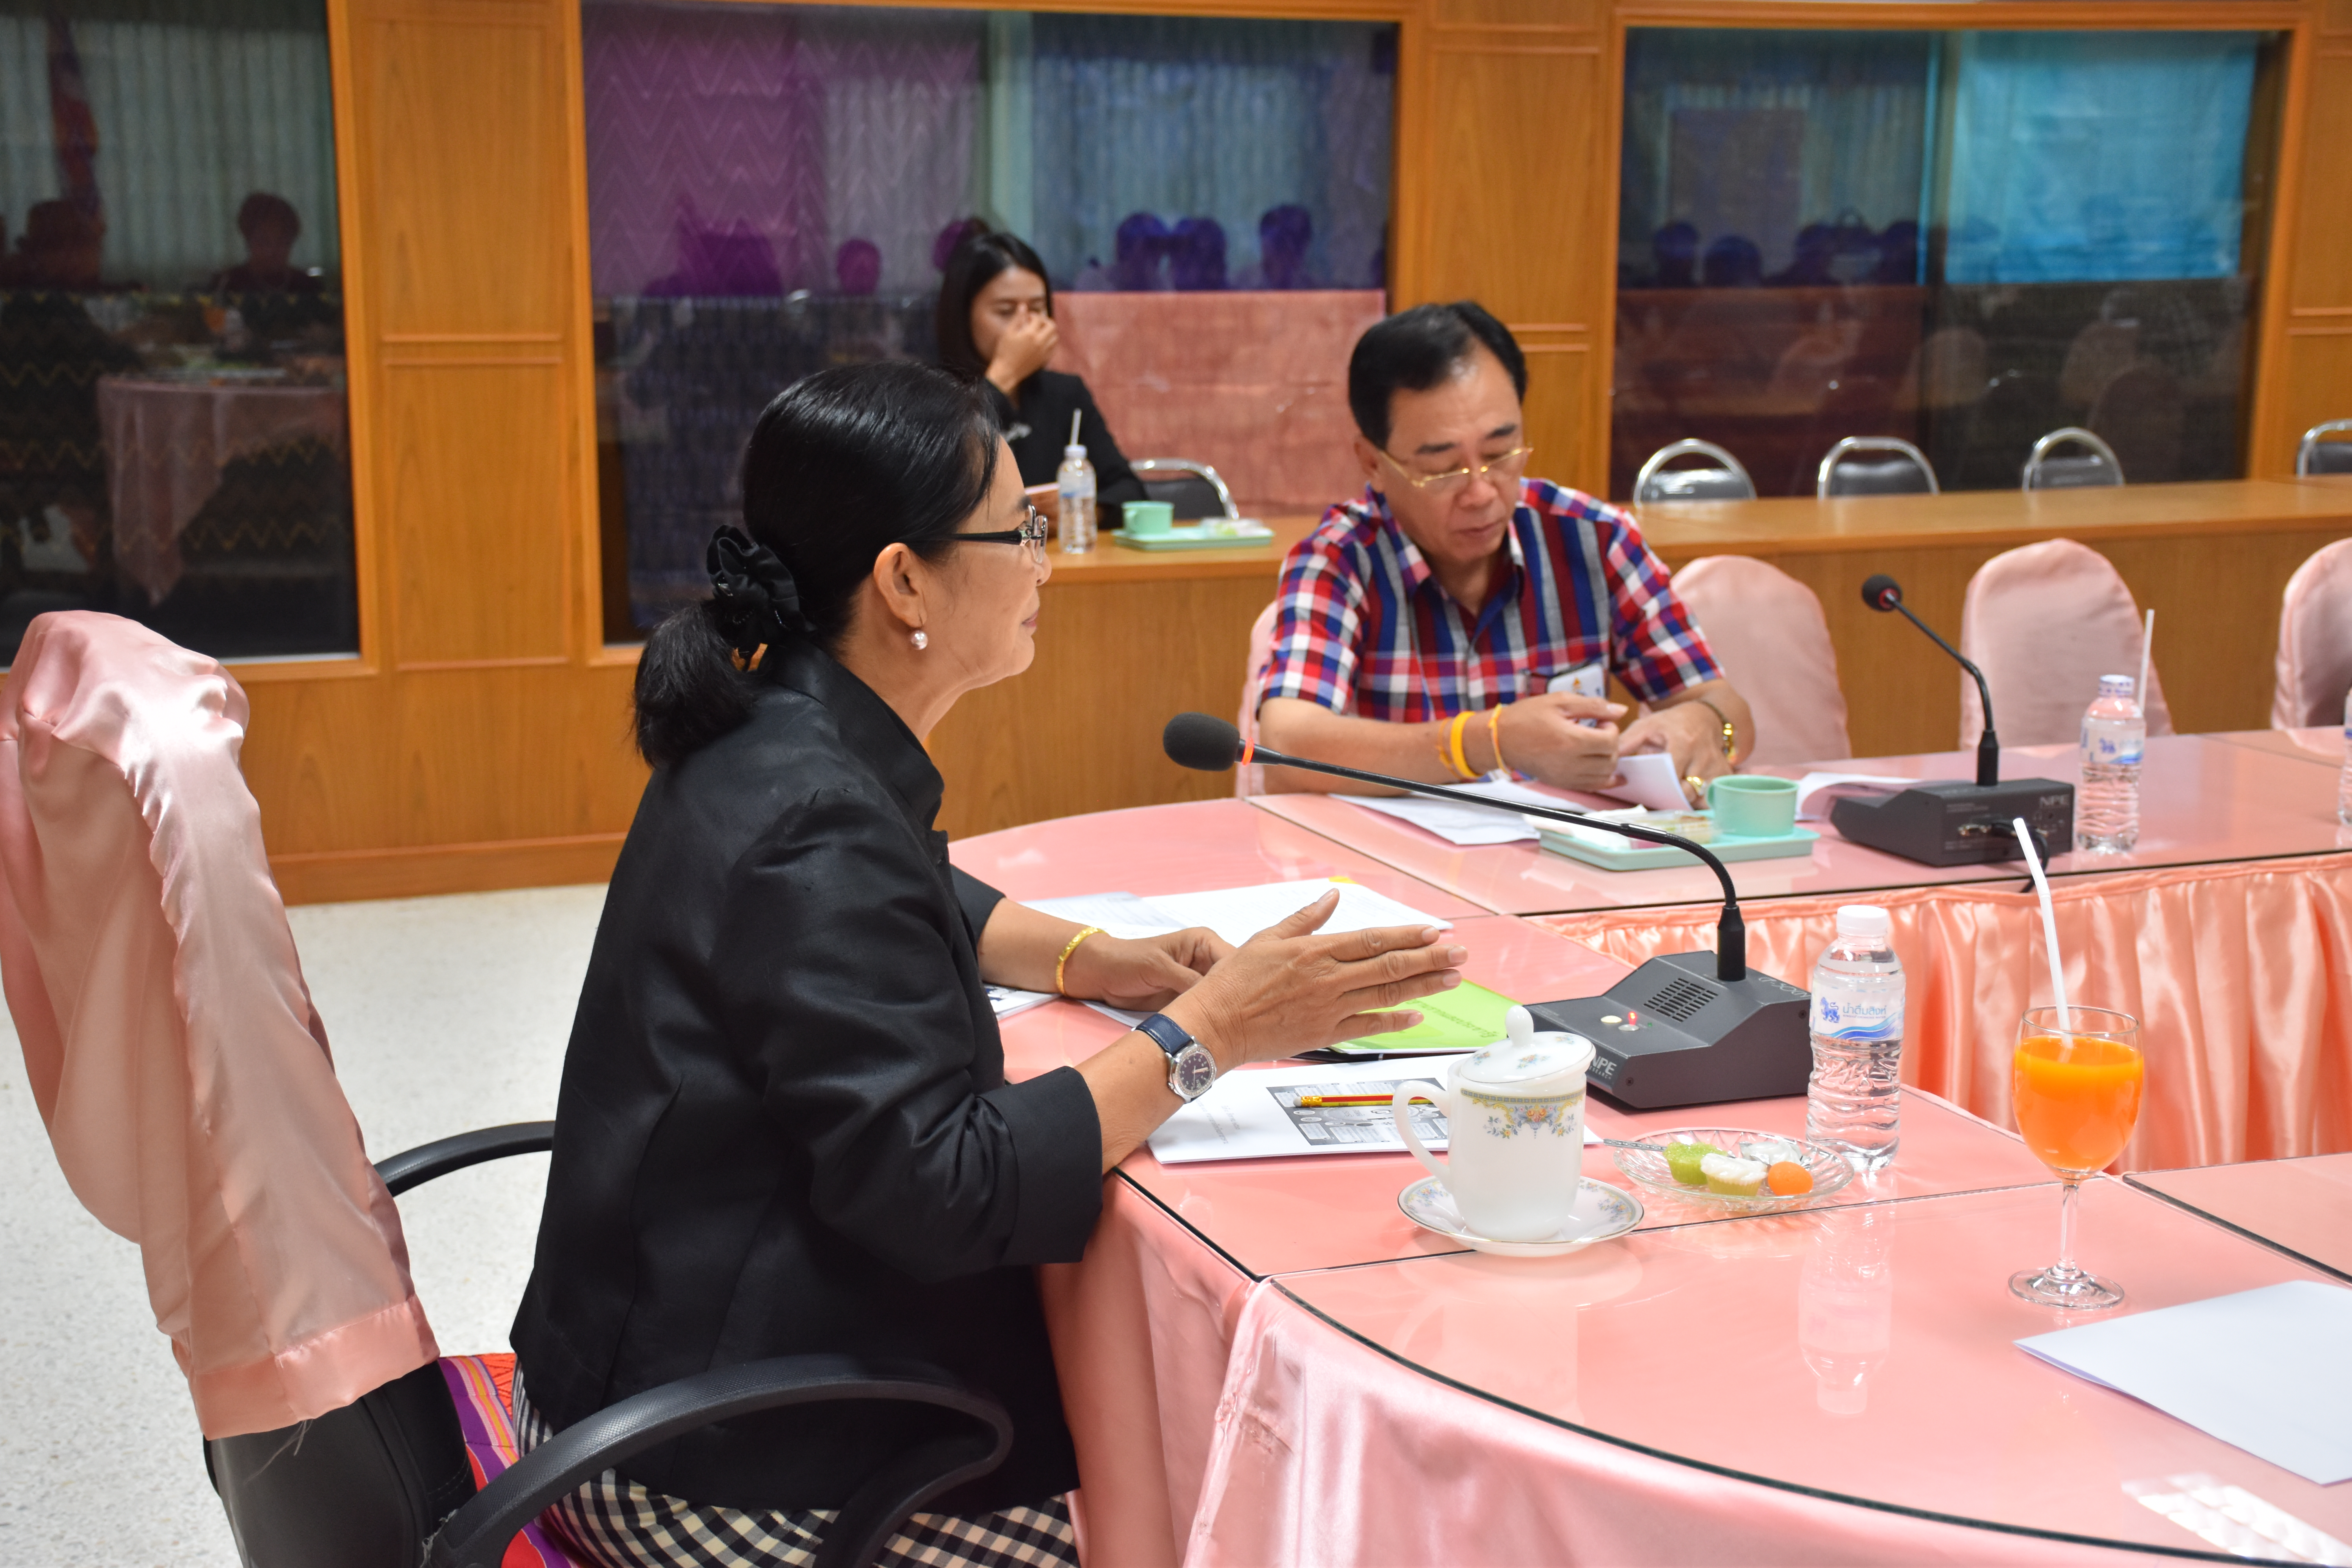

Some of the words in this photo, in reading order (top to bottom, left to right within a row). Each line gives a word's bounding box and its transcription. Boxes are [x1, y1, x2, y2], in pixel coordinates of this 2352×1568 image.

[1843, 1002, 1887, 1015] น้ำดื่มสิงห์
